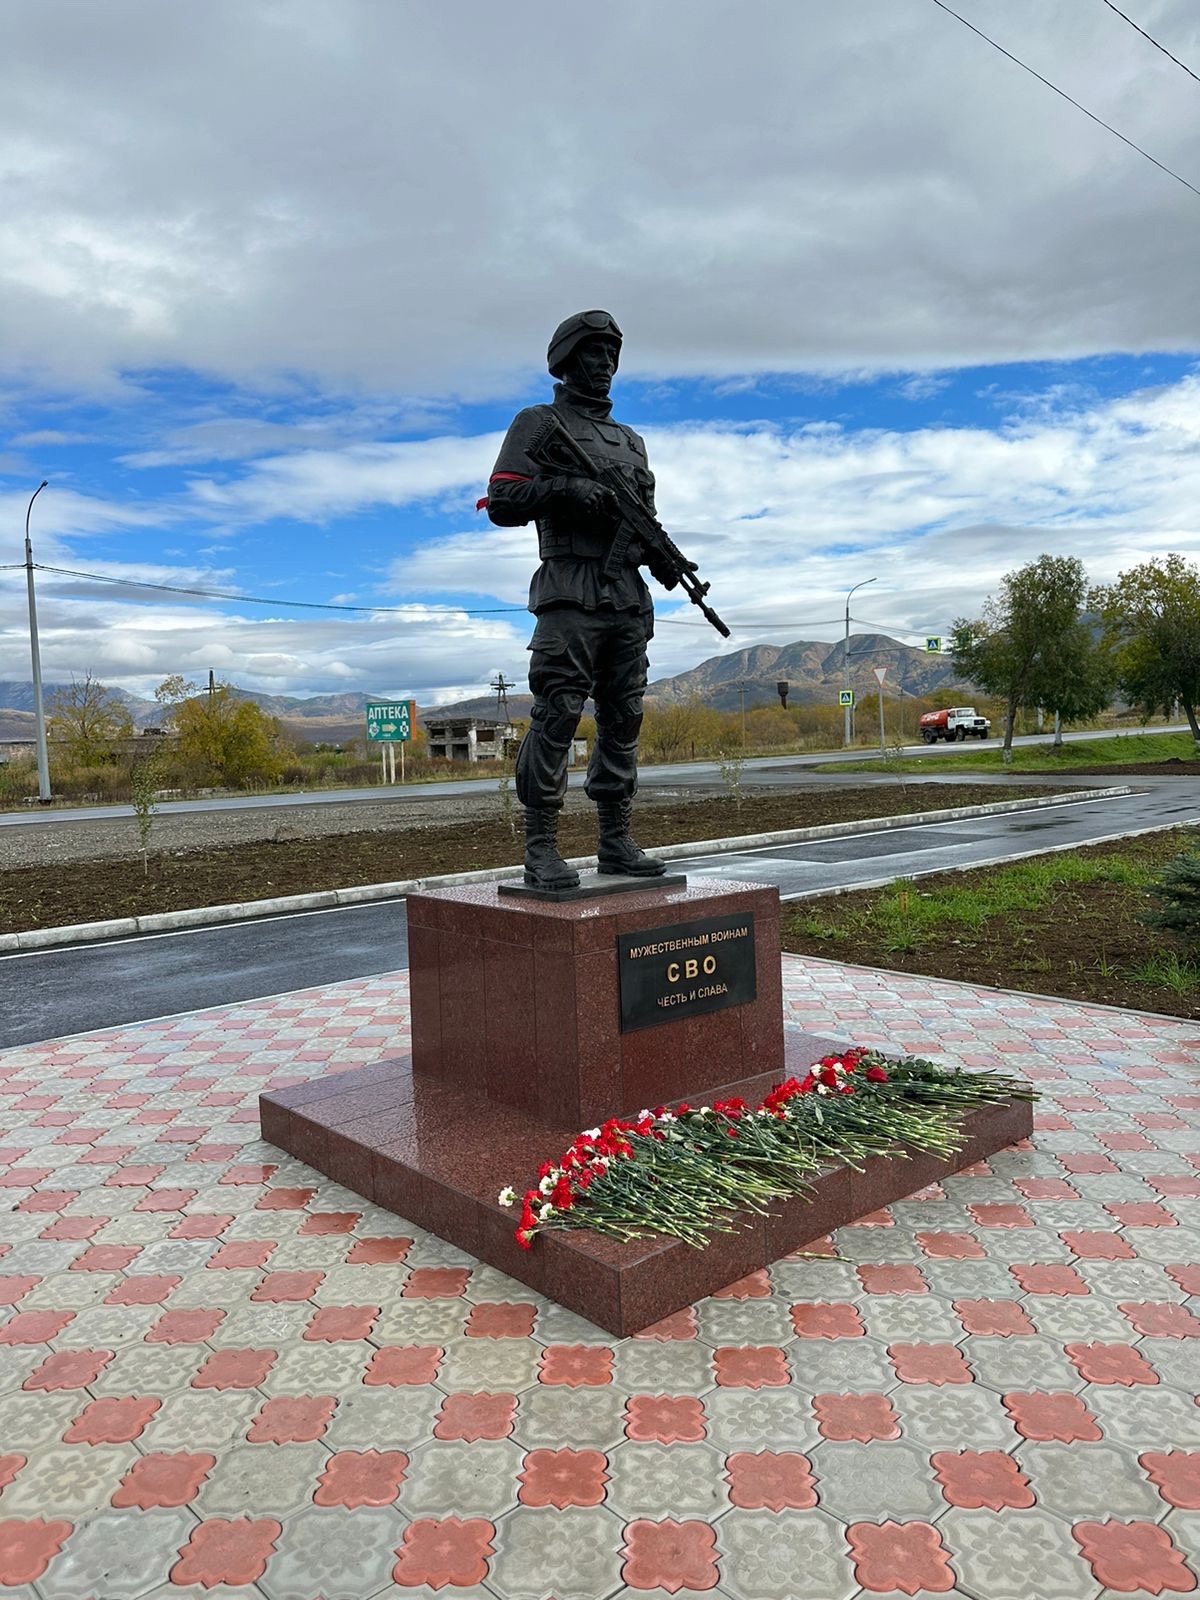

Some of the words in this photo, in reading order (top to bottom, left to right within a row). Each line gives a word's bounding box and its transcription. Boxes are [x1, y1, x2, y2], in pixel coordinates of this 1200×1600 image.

[368, 706, 409, 720] АПТЕКА
[630, 934, 709, 959] МУЖЕСТВЕННЫМ
[711, 927, 748, 943] ВОИНАМ
[667, 955, 717, 983] СВО
[657, 993, 688, 1008] ЧЕСТЬ
[690, 991, 696, 1001] И
[697, 983, 728, 999] СЛАВА
